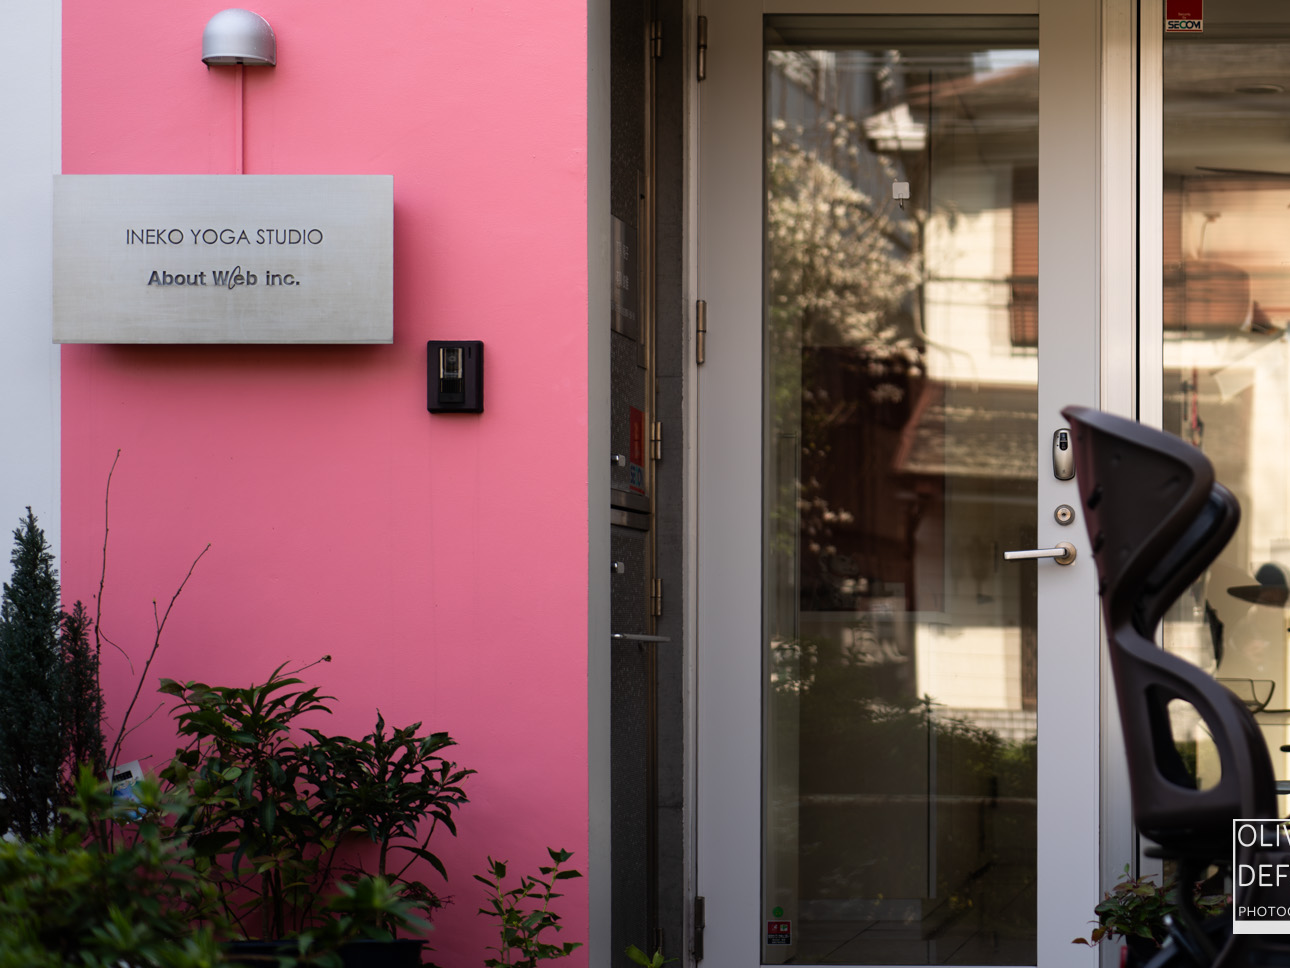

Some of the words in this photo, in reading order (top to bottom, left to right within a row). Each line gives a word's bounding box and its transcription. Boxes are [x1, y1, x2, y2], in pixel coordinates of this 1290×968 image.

[1168, 20, 1201, 29] SECOM
[126, 228, 184, 245] INEKO
[190, 228, 251, 245] YOGA
[256, 228, 324, 245] STUDIO
[148, 270, 207, 287] About
[212, 265, 258, 290] Web
[265, 270, 301, 287] inc.
